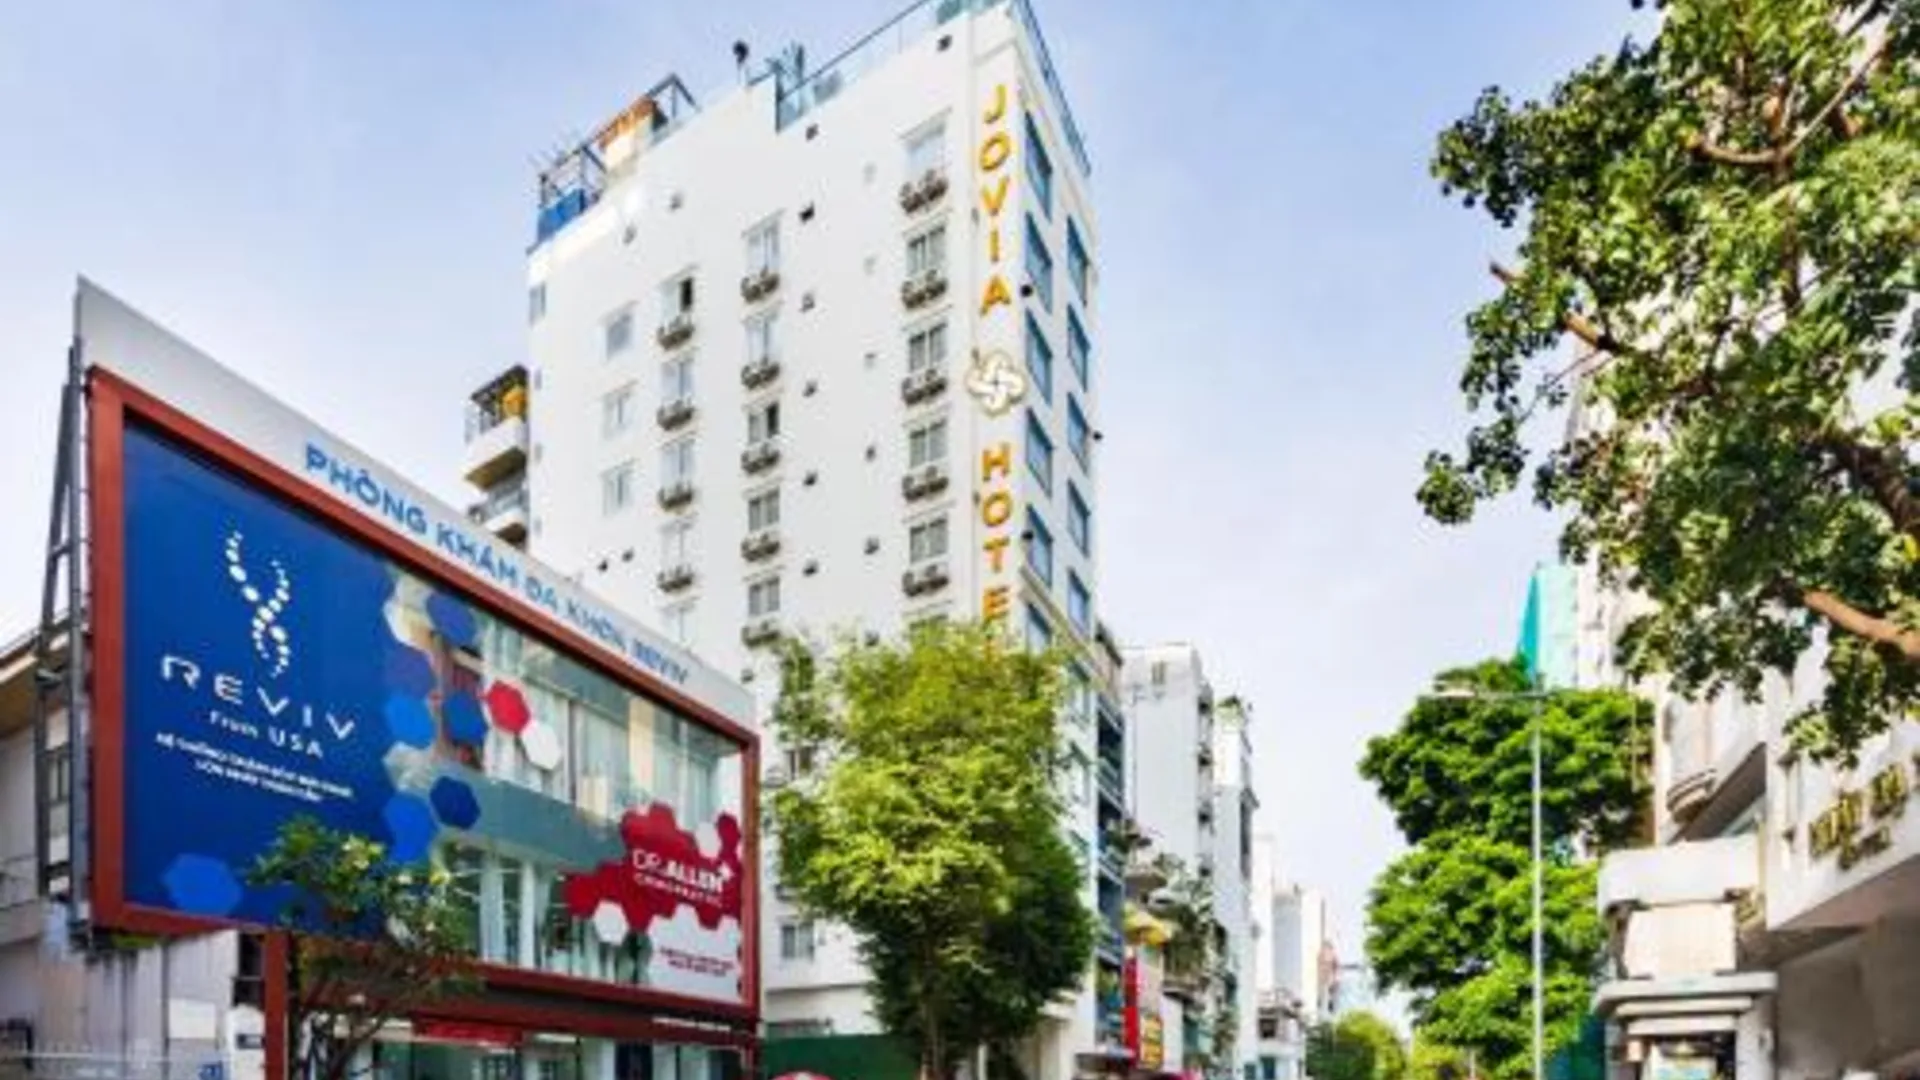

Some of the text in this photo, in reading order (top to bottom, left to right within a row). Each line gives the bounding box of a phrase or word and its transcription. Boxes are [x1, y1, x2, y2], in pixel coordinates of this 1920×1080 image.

[979, 83, 1011, 317] JOVIA
[161, 654, 355, 740] REVIV
[267, 726, 324, 759] USA
